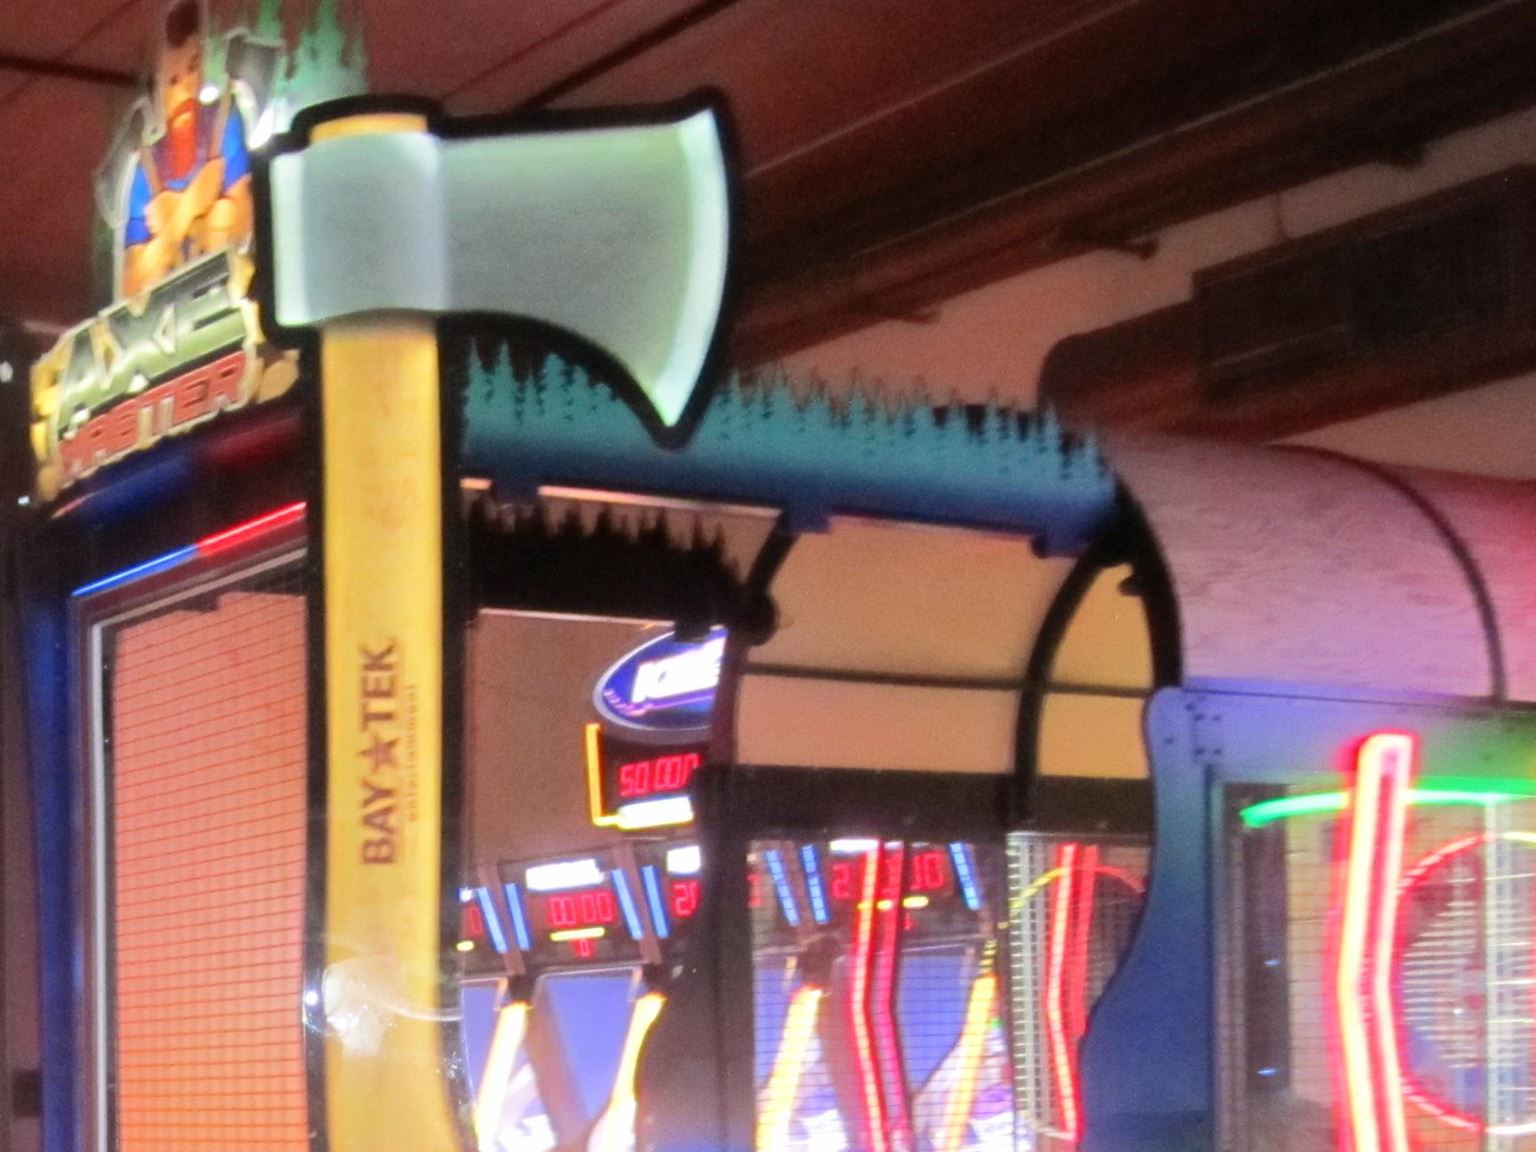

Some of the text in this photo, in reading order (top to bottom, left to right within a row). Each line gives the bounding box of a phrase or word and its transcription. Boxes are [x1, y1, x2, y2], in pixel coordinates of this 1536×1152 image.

[56, 350, 249, 480] MASTER
[58, 252, 248, 438] AXE
[360, 637, 397, 864] BAY TEK
